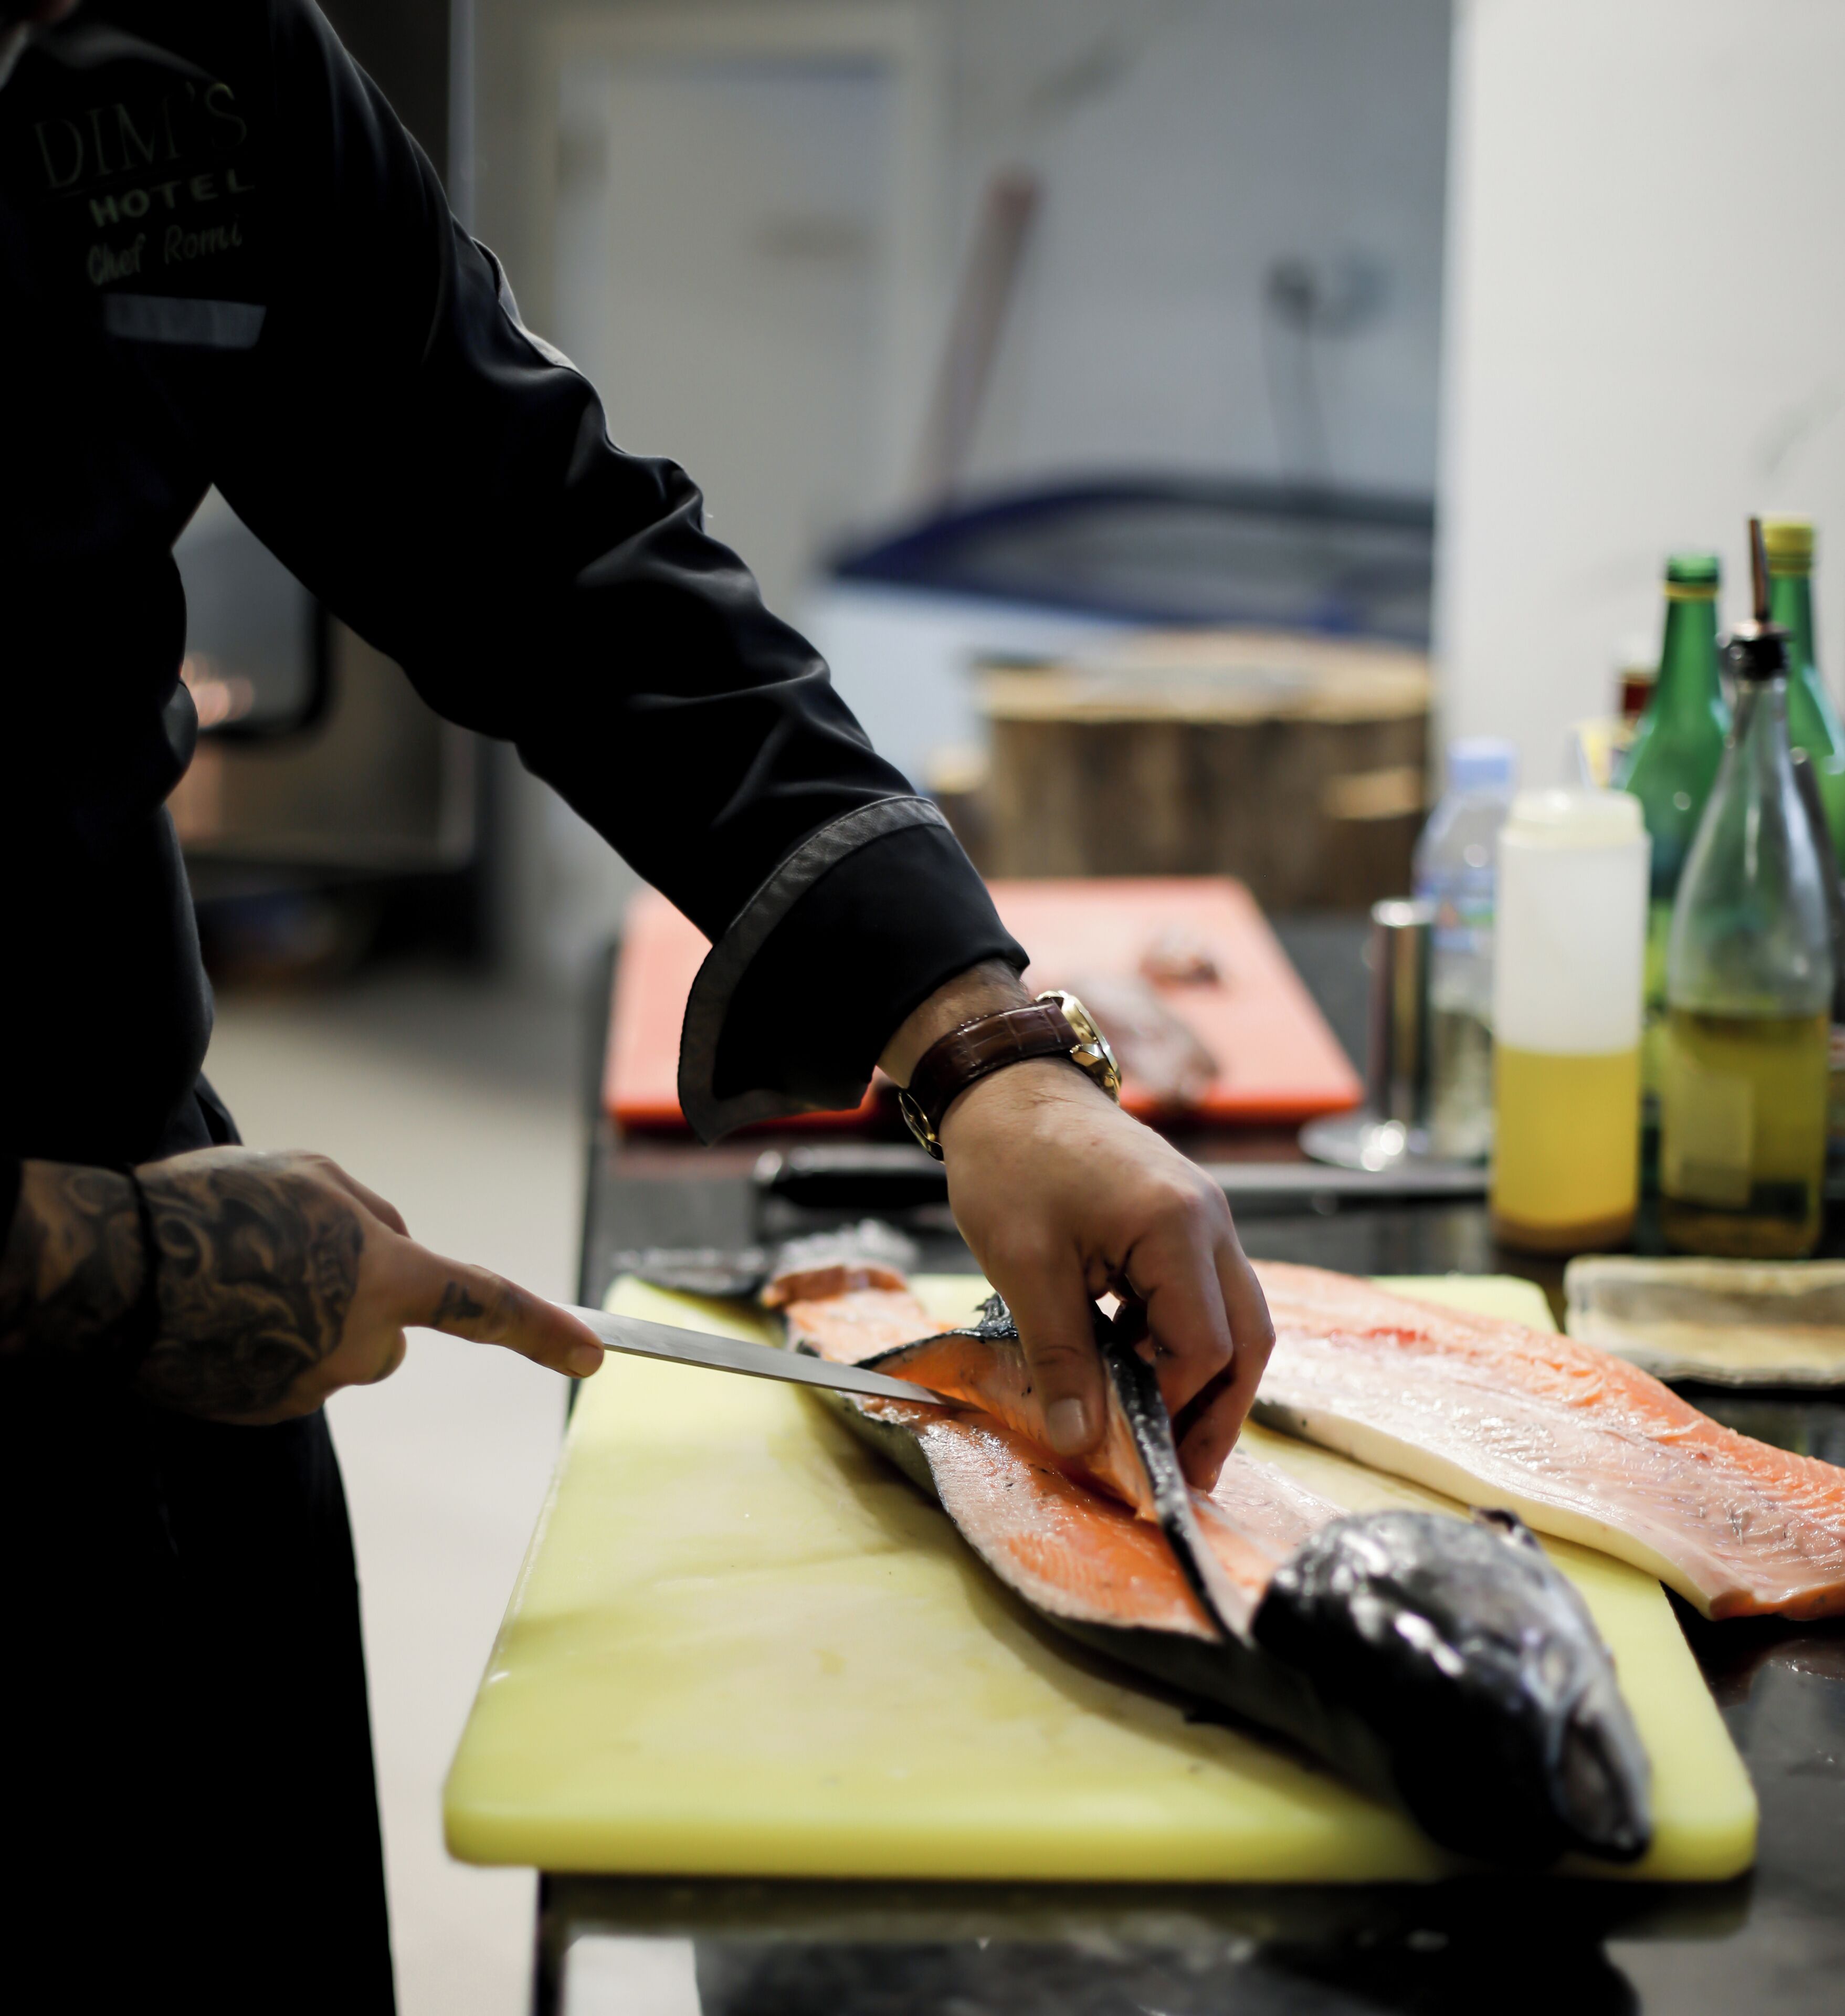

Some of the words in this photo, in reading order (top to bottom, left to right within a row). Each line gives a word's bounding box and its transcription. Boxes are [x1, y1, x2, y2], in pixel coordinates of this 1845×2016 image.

[31, 81, 247, 188] DIM'S
[88, 168, 255, 228] HOTEL
[85, 232, 146, 287] Chef
[163, 212, 243, 265] Romi
